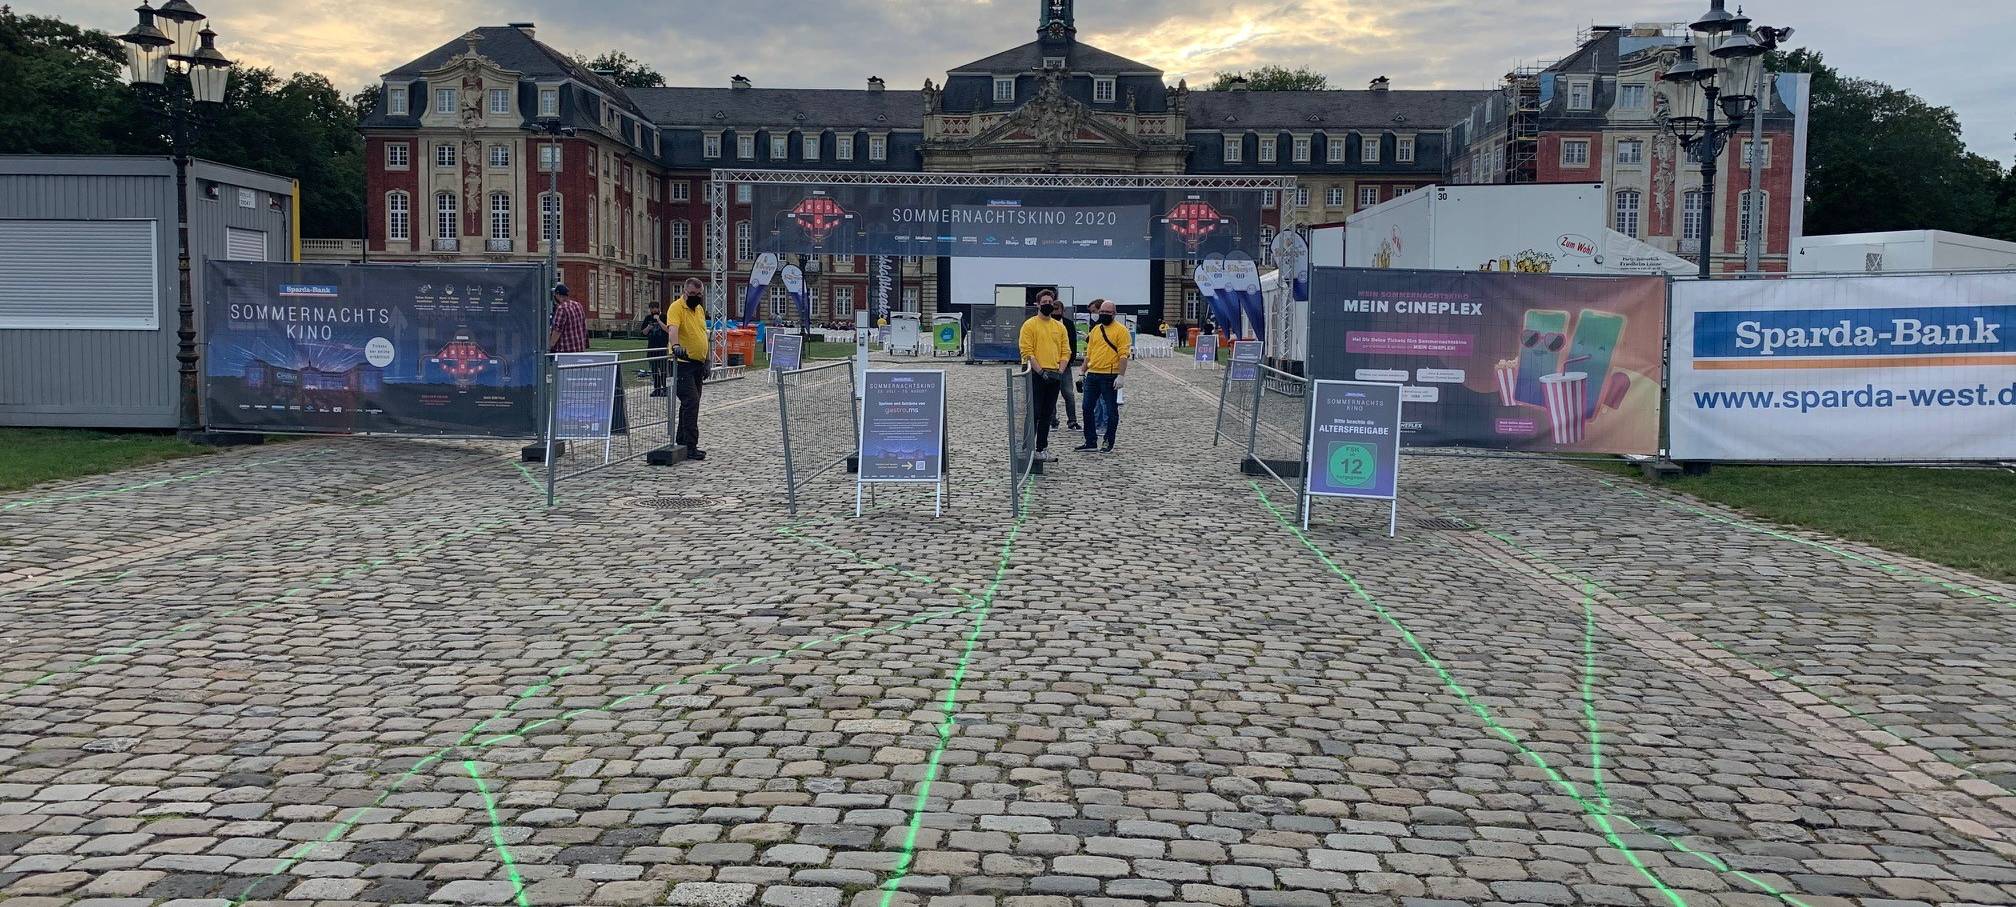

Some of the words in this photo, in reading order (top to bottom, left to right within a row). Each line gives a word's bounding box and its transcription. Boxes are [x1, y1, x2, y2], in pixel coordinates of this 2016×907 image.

[892, 208, 1066, 225] SOMMERNACHTSKINO
[1075, 211, 1117, 225] 2020
[1561, 236, 1575, 248] Zum
[231, 304, 389, 324] SOMMERNACHTS
[1344, 300, 1389, 312] MEIN
[1395, 301, 1482, 316] CINEPLEX
[287, 324, 332, 340] KINO
[1736, 317, 2000, 354] Sparda-Bank
[1319, 424, 1389, 435] ALTERSFREIGABE
[1341, 459, 1362, 474] 12
